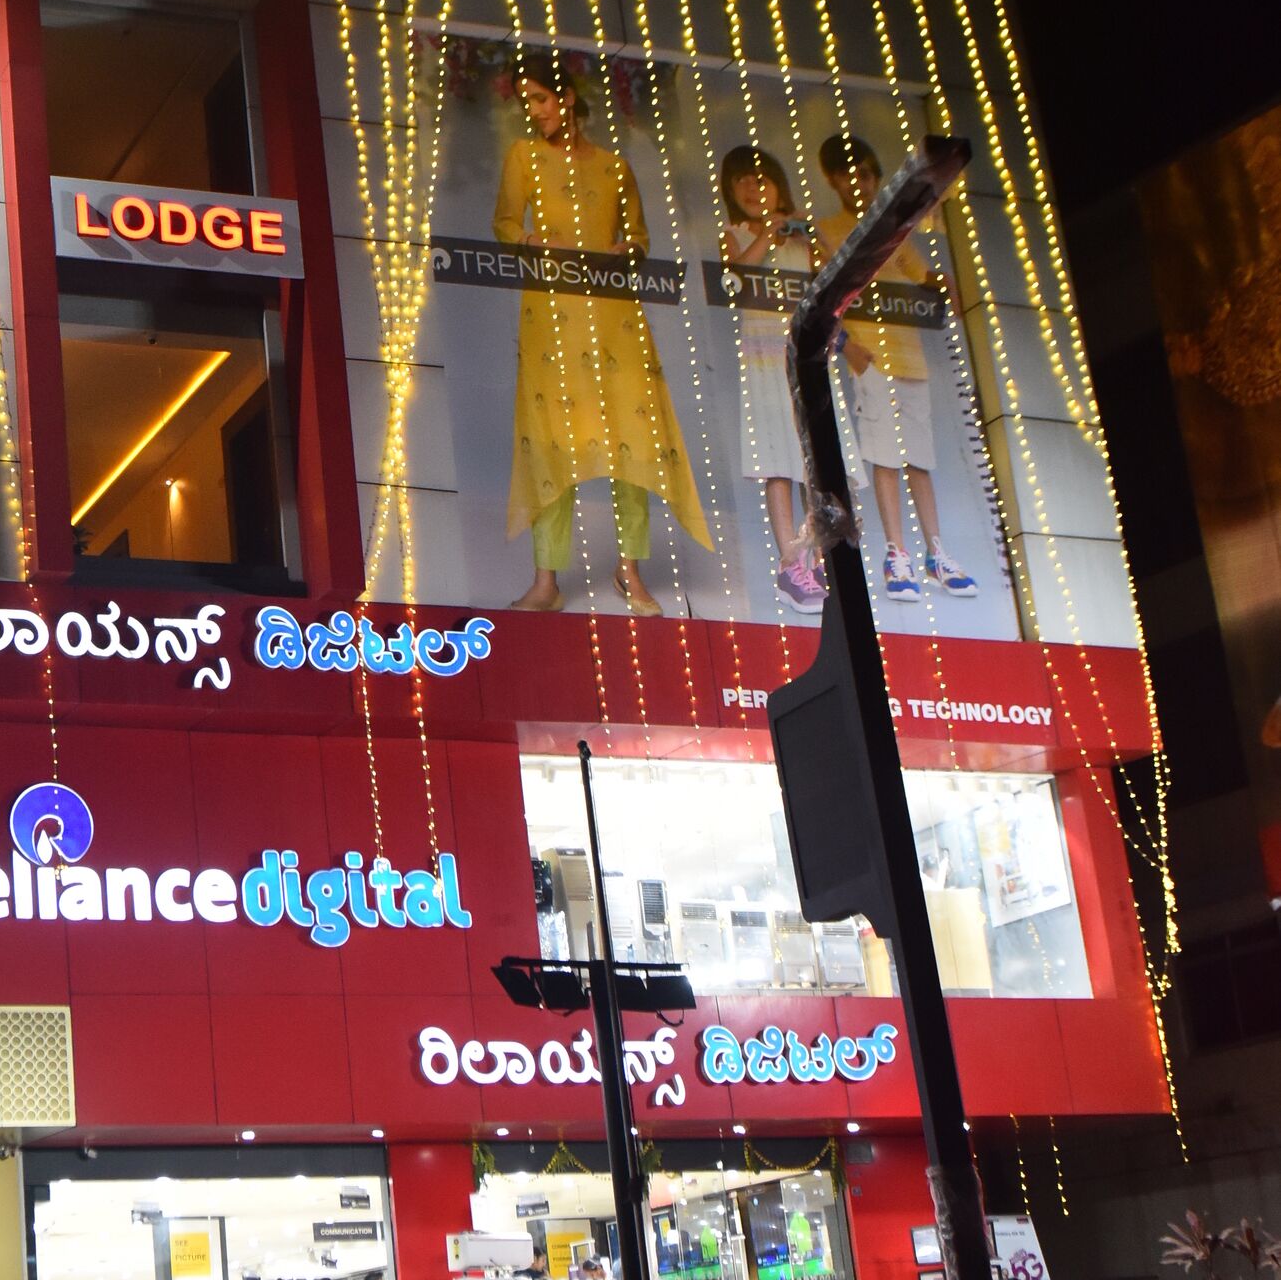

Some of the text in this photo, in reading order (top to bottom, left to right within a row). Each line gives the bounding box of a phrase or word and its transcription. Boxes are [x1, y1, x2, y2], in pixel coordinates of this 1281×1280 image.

[75, 192, 287, 255] LODGE
[453, 249, 581, 284] TRENDS
[254, 605, 496, 677] ಡಿಜಿಟಲ್
[907, 698, 1052, 726] TECHNOLOGY
[700, 1023, 898, 1085] ಡಿಜಿಟಲ್
[320, 1227, 373, 1236] COMMUNICATION
